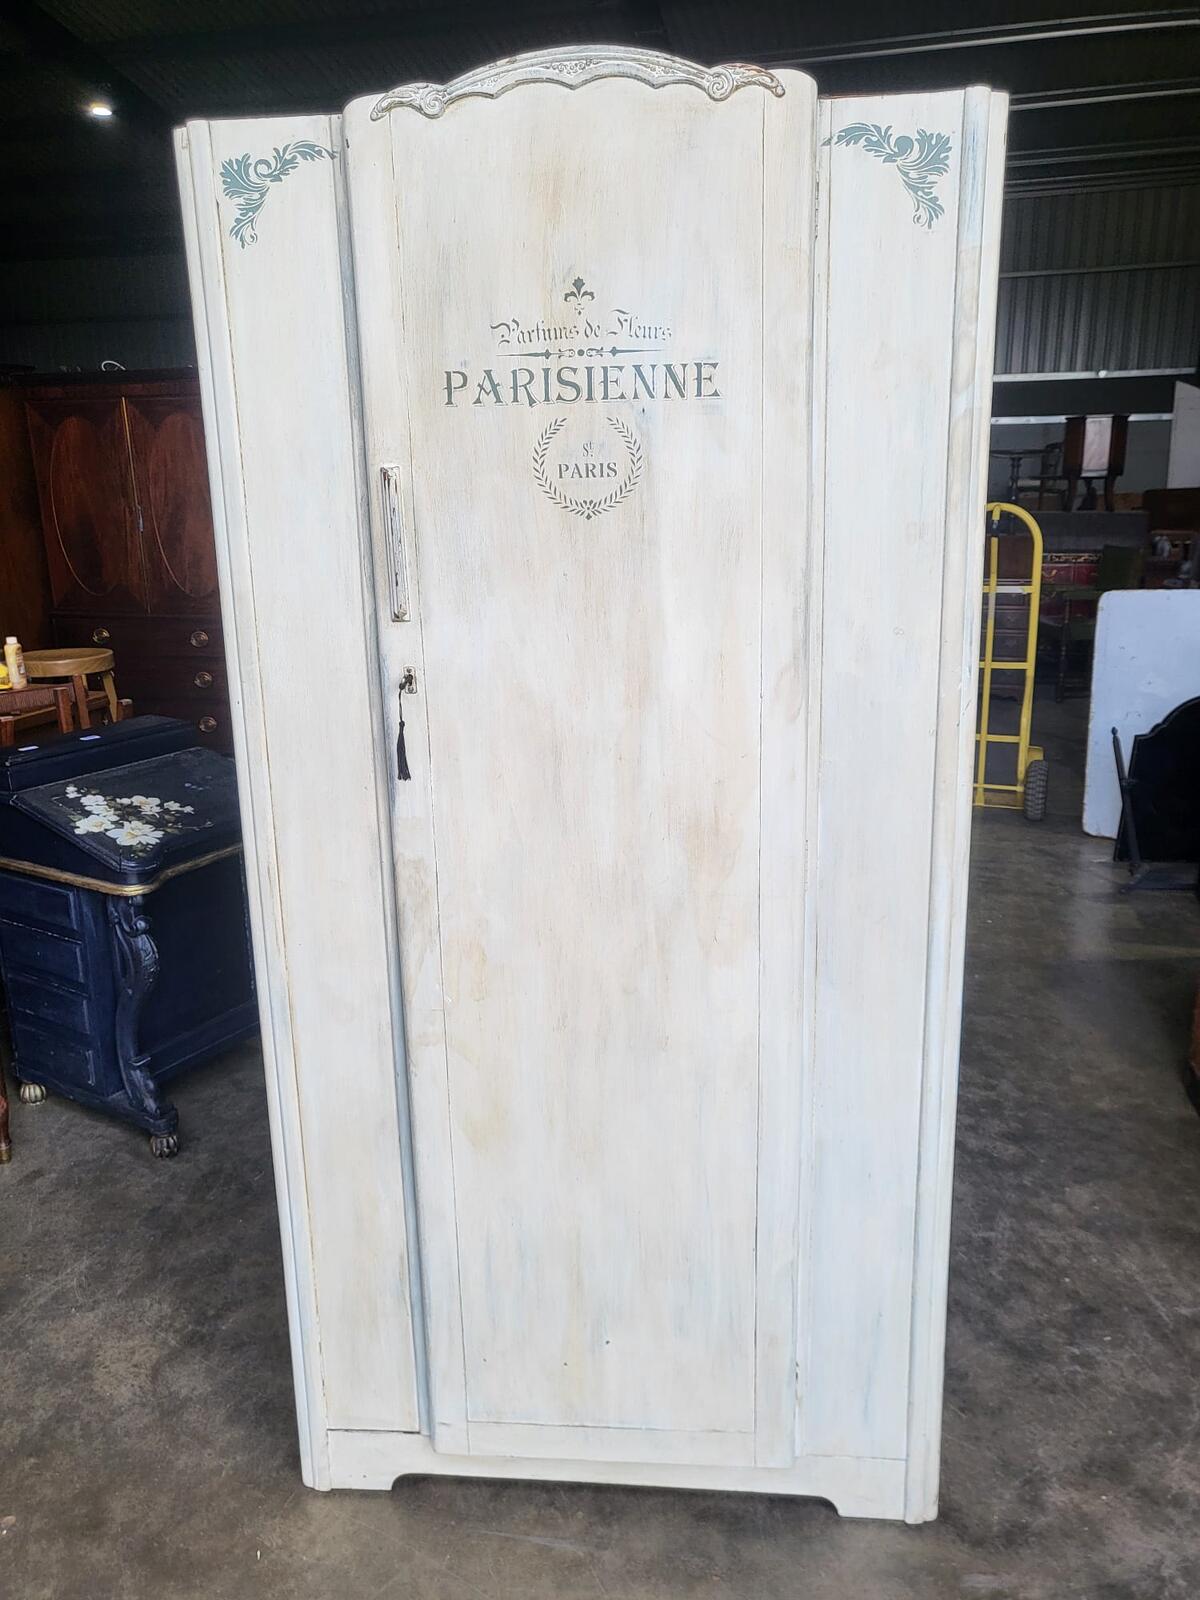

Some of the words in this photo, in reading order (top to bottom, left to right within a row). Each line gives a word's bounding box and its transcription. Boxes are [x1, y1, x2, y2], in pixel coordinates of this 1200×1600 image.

[490, 318, 579, 347] Parfums
[584, 319, 601, 338] de
[607, 308, 672, 341] Fleurs
[443, 362, 721, 407] PARISIENNE
[558, 462, 618, 479] PARIS
